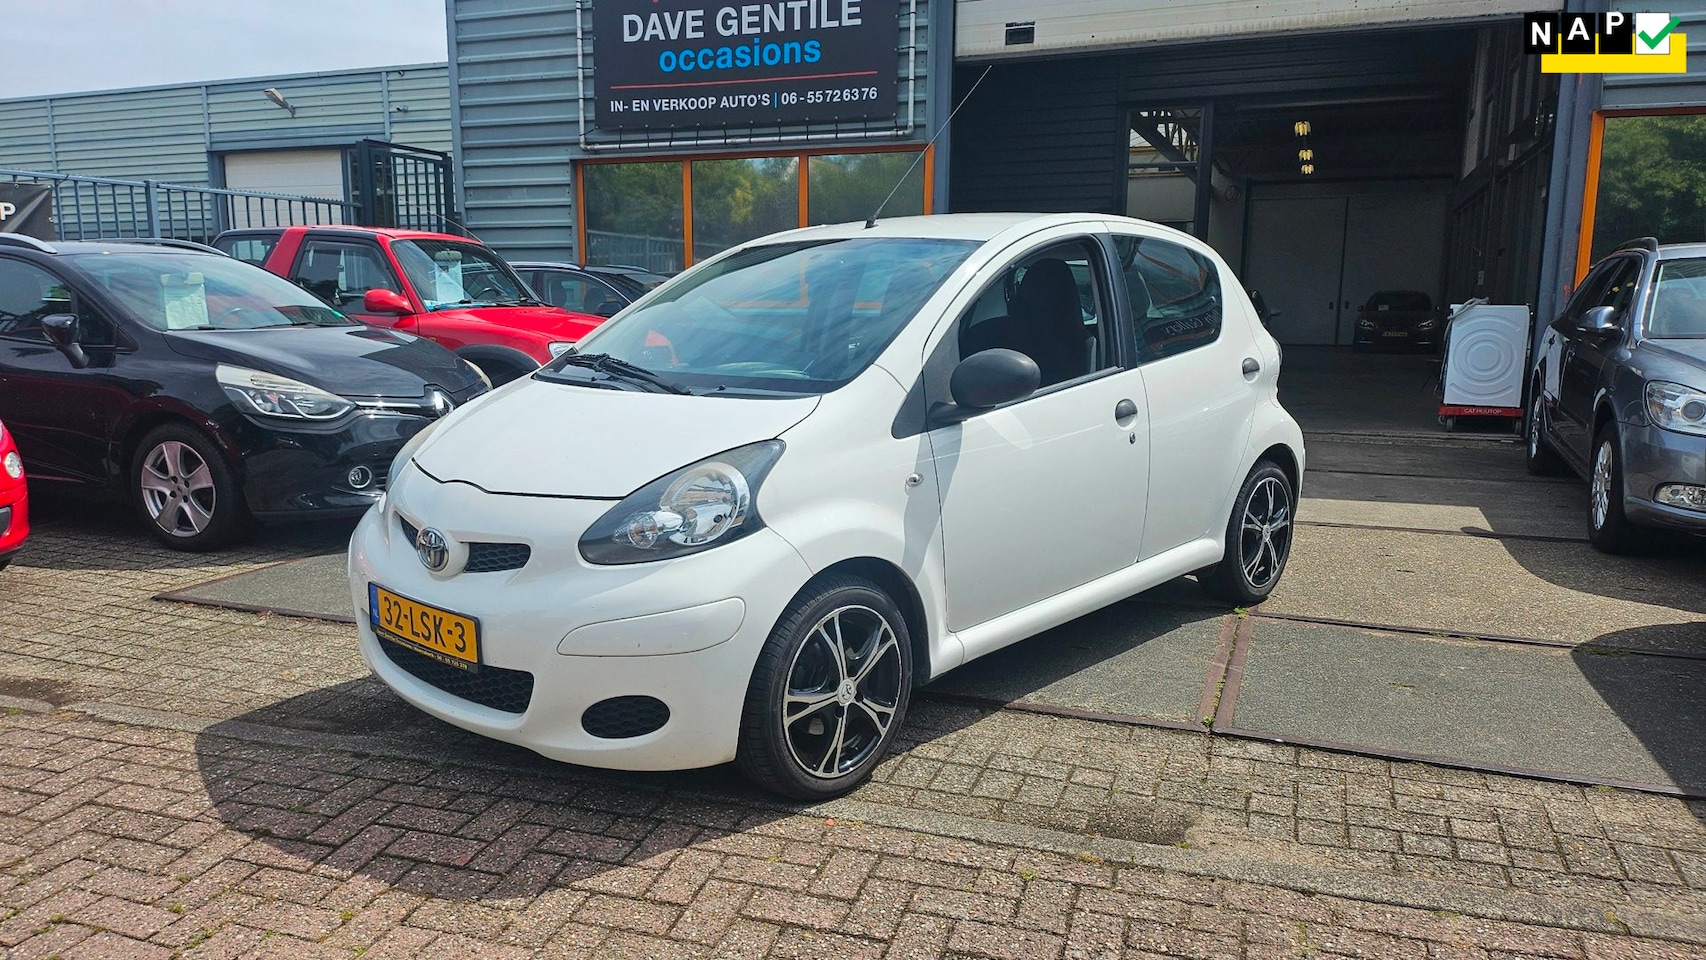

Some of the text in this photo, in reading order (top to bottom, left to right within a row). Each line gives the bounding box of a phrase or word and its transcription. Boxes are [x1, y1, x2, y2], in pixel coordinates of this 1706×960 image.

[623, 0, 862, 43] DAVE GENTILE
[659, 37, 822, 72] occasions
[610, 100, 629, 112] IN-
[632, 100, 650, 112] EN
[652, 96, 717, 111] VERKOOP
[719, 94, 771, 109] AUTO'S
[383, 596, 467, 653] 32-LSK-3
